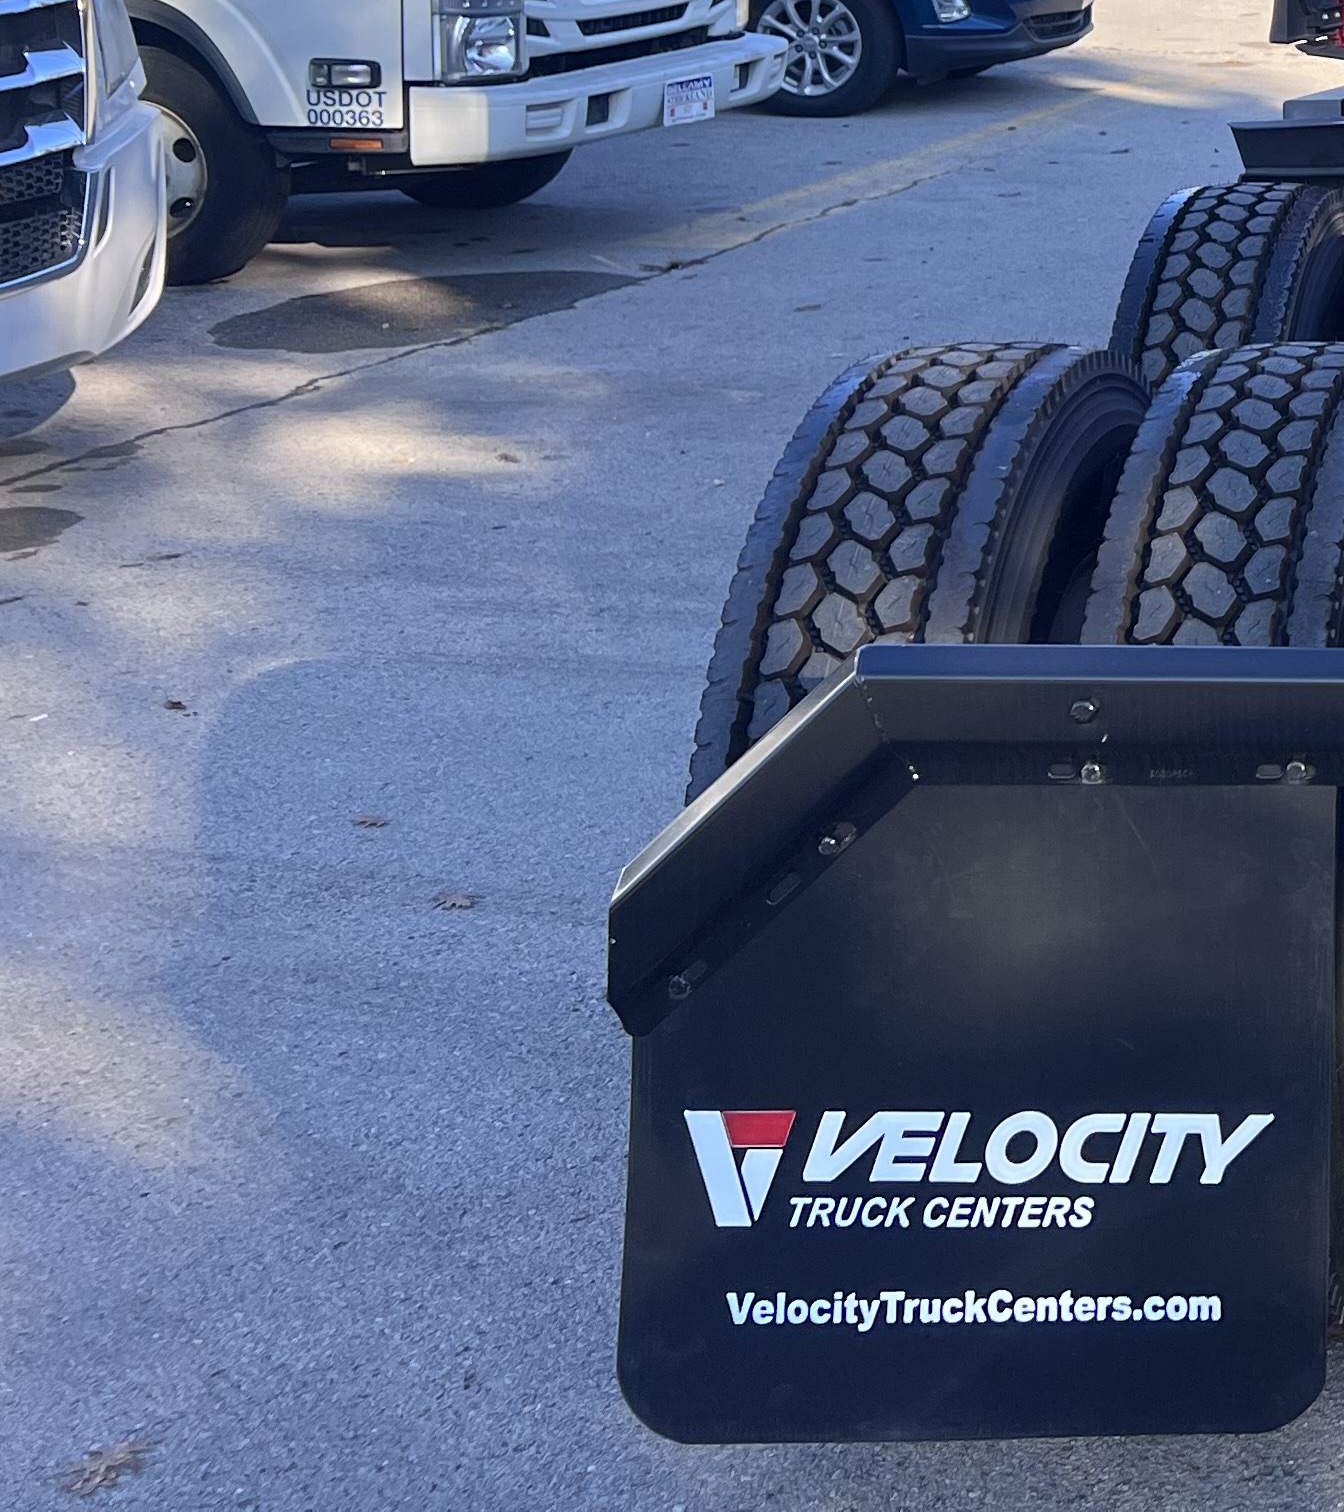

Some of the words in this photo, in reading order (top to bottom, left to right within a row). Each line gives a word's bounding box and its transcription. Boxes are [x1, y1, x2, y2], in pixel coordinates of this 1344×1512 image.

[306, 89, 387, 107] USDOT
[307, 109, 384, 126] 000363
[802, 1110, 1275, 1185] VELOCITY
[788, 1196, 918, 1229] TRUCK
[922, 1196, 1095, 1229] CENTERS
[726, 1290, 1222, 1331] VelocityTruckCenters.com
